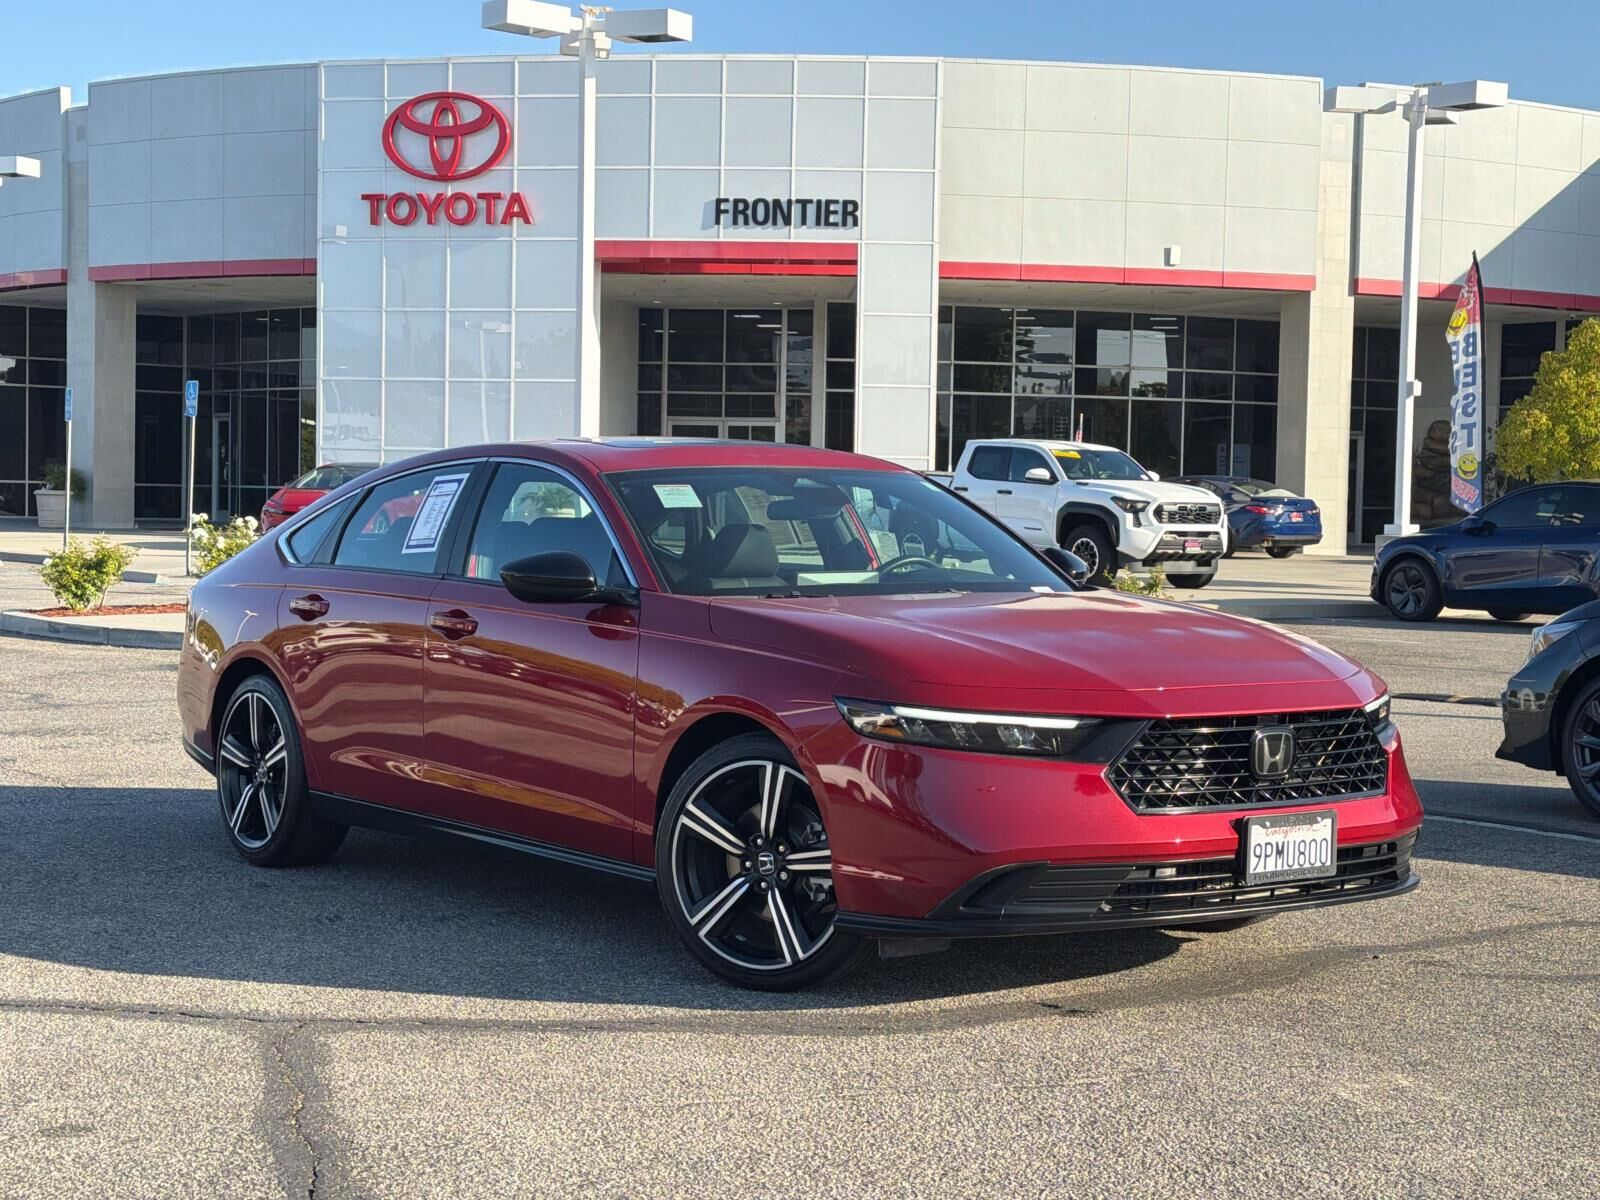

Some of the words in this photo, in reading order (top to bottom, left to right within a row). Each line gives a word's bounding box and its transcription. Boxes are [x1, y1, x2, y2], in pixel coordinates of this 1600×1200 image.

[361, 191, 534, 226] TOYOTA
[714, 197, 860, 227] FRONTIER
[1252, 837, 1329, 872] 9PMU800
